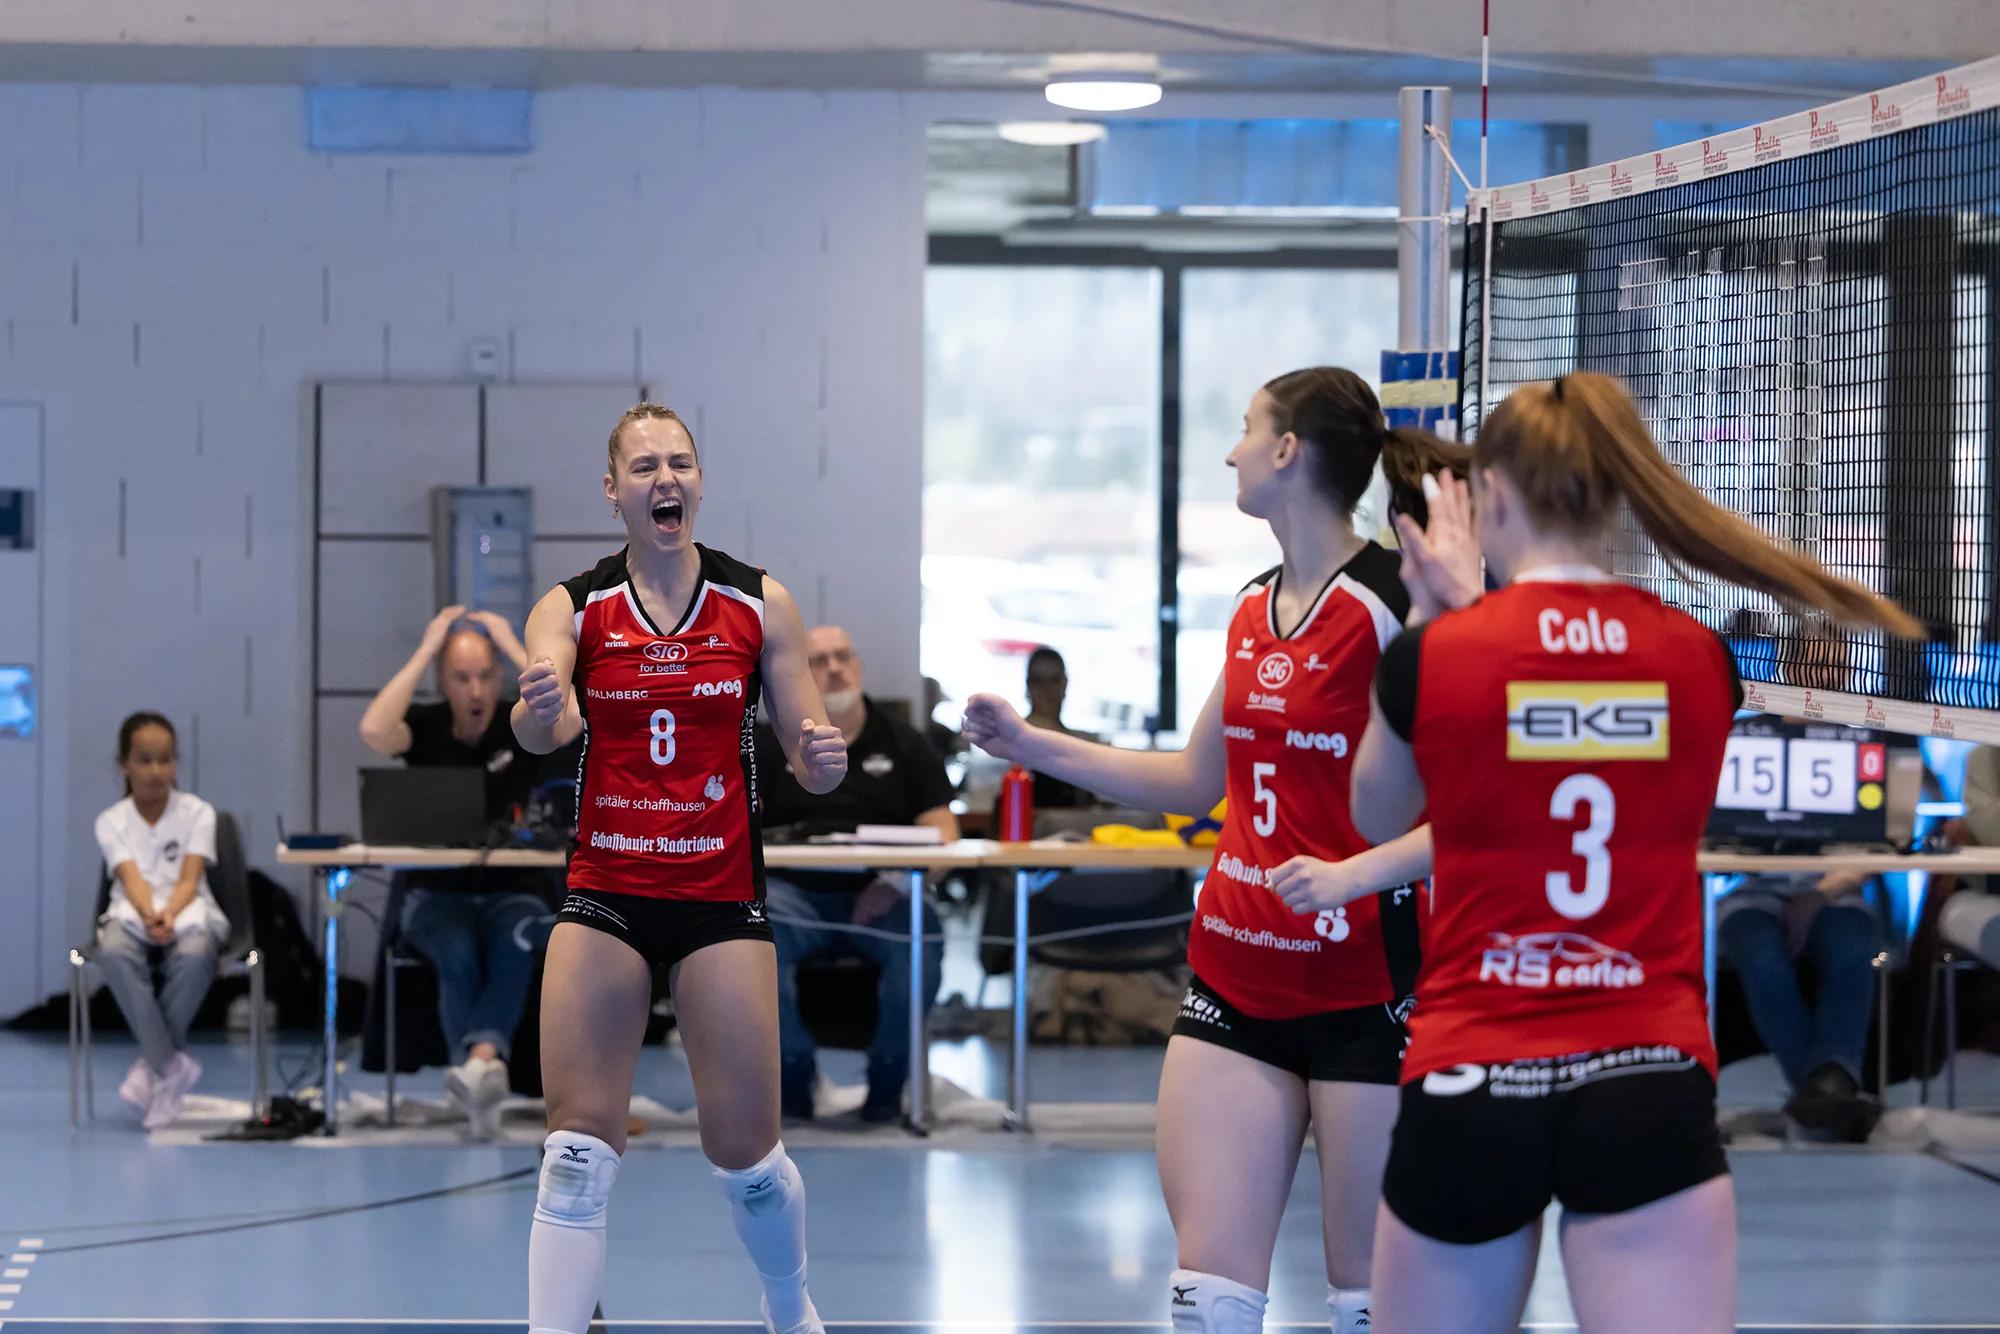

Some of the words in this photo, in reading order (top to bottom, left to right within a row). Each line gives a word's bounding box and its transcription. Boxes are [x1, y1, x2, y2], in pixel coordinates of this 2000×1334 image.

[1538, 607, 1628, 655] Cole
[639, 663, 654, 673] for
[656, 663, 687, 673] better
[650, 645, 680, 660] SIG
[1262, 660, 1290, 682] SIG
[590, 688, 649, 700] PALMBERG
[692, 678, 742, 699] sasag
[650, 708, 676, 766] 8
[740, 707, 751, 756] ACTIVE
[1508, 703, 1668, 740] EKS
[747, 704, 759, 814] Dermaplast
[1727, 755, 1774, 795] 15
[1811, 759, 1832, 798] 5
[1862, 751, 1879, 777] 0
[595, 794, 630, 808] spitäler
[632, 797, 706, 812] schaffhausen
[1253, 762, 1278, 837] 5
[657, 836, 725, 854] Nachrichten
[1546, 773, 1617, 920] 3
[1201, 914, 1234, 938] spitäler
[1233, 926, 1321, 953] schaffhausen
[1479, 948, 1550, 989] RS
